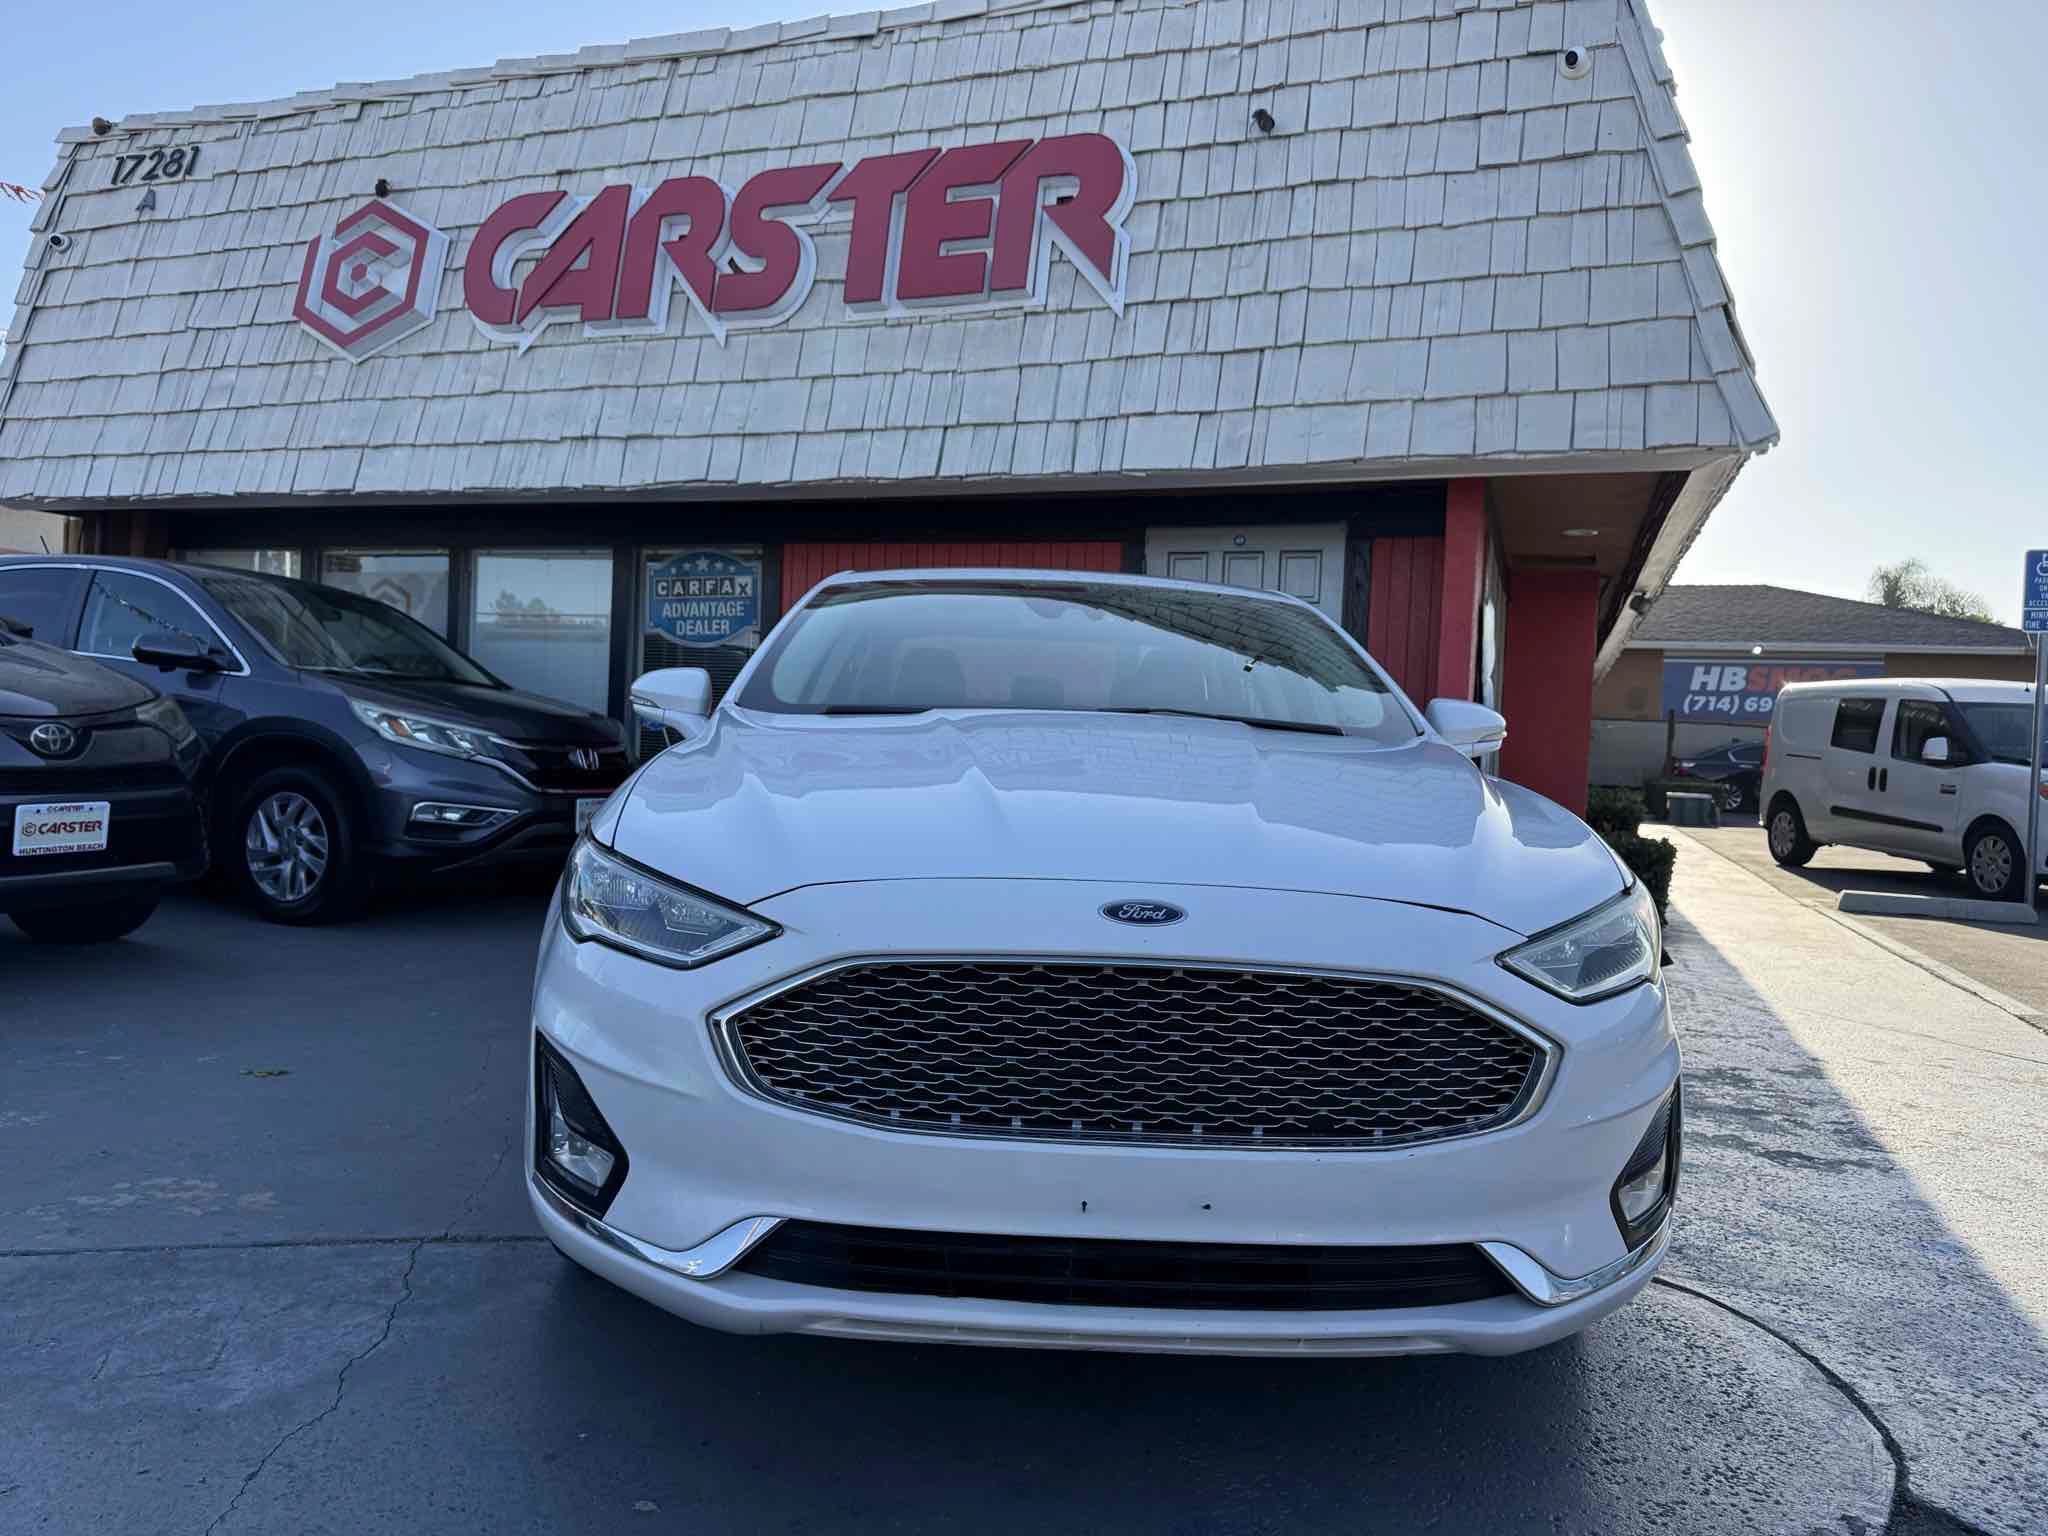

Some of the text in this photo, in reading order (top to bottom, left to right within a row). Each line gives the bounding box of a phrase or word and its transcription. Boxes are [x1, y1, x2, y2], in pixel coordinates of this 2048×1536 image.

[111, 145, 200, 186] 17281
[136, 189, 156, 212] A
[463, 132, 1130, 332] CARSTER
[656, 578, 752, 598] CARFAX
[662, 601, 746, 619] ADVANTAGE
[675, 620, 731, 636] DEALER
[1683, 694, 1774, 714] (714) 69
[38, 820, 103, 835] CARSTER
[1118, 903, 1168, 920] Ford
